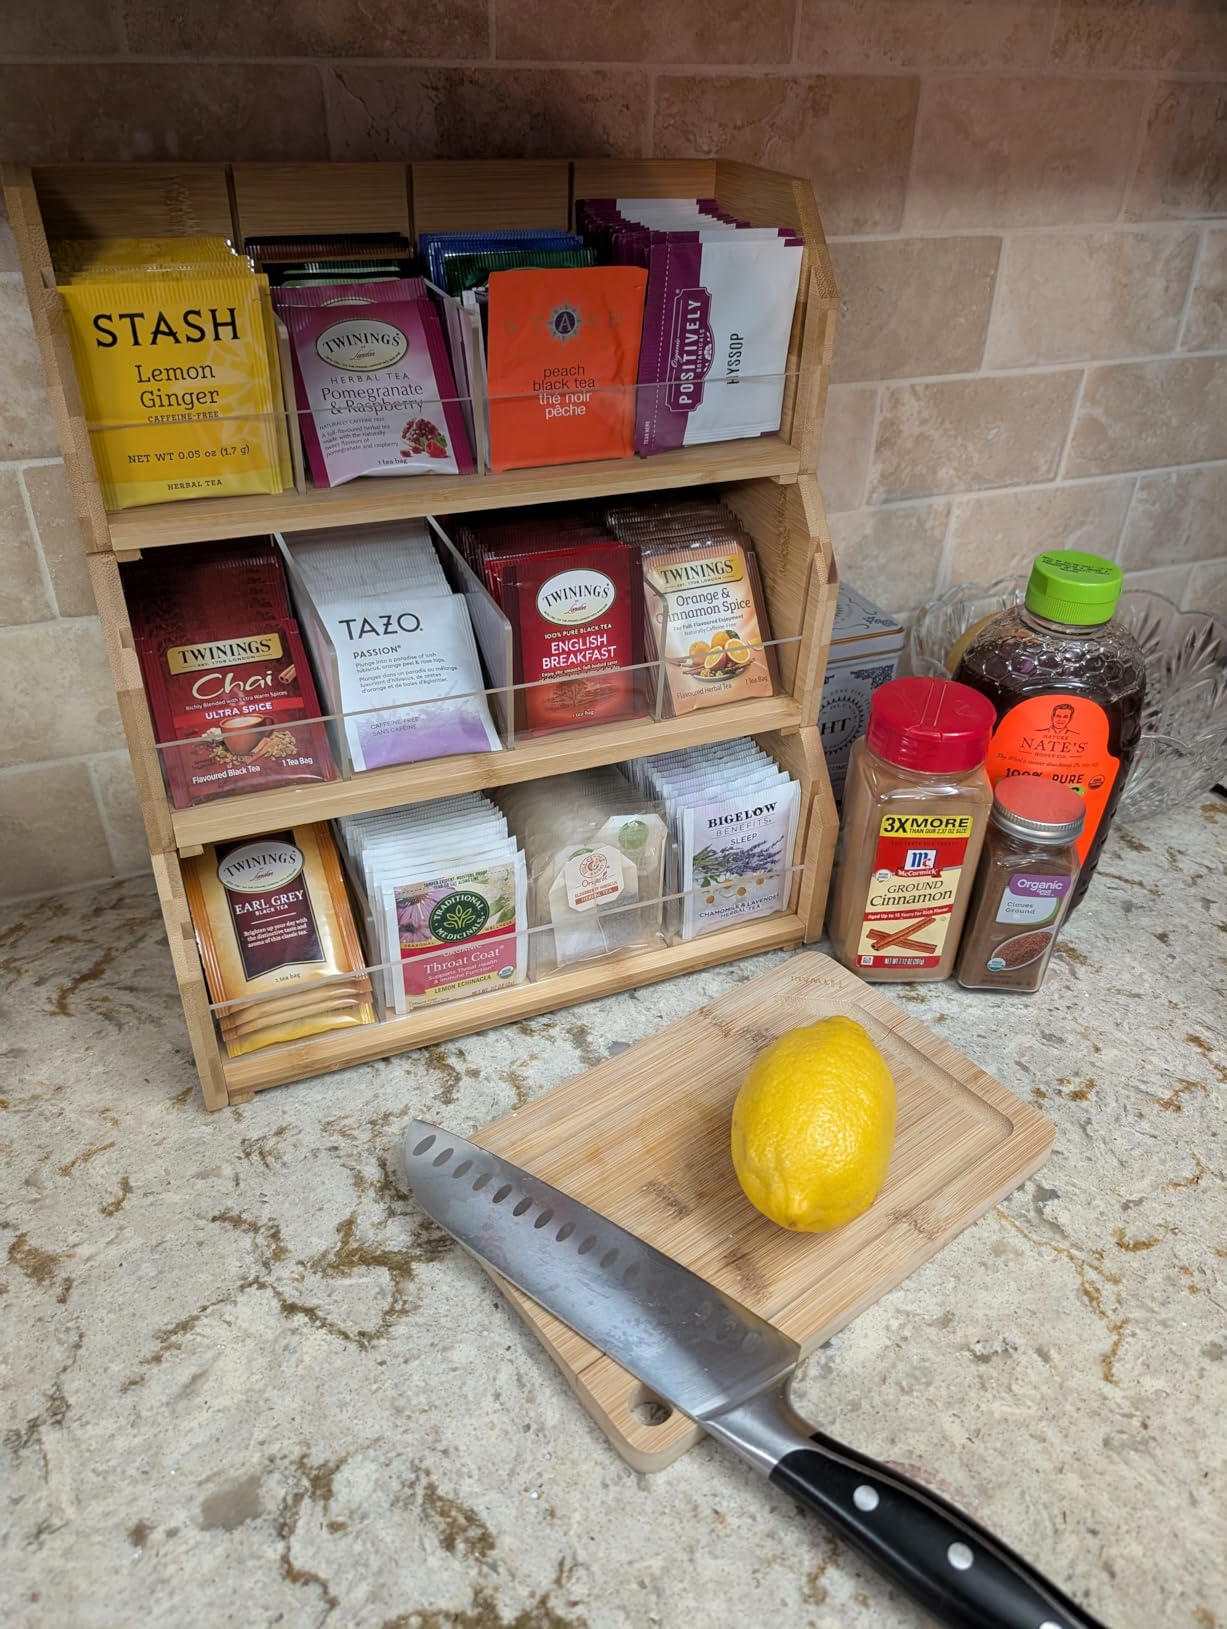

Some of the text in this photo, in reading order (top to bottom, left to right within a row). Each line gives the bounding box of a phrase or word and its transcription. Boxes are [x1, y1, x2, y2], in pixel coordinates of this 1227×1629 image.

[92, 307, 241, 349] STASH
[322, 331, 401, 353] TWININGS
[678, 299, 702, 404] POSITIVELY
[696, 328, 706, 373] BOTANICALS
[726, 332, 744, 386] HYSSOP
[134, 364, 216, 384] Lemon
[330, 372, 410, 385] HERBAL TEA
[543, 364, 585, 380] peach
[321, 383, 424, 402] Pomegranate
[532, 377, 595, 393] black tea
[140, 389, 219, 411] Ginger
[539, 390, 592, 405] thé noir
[147, 410, 219, 424] CAFFEINE-FREE
[330, 398, 424, 417] & Raspberry
[545, 404, 586, 420] pêche
[127, 444, 250, 465] NET WT 0.05 oz (1.7 g)
[167, 479, 222, 491] HERBAL TEA
[660, 558, 734, 584] TWININGS
[542, 582, 610, 608] TWININGS
[676, 587, 731, 608] Orange &
[656, 598, 751, 625] Cinnamon Spice
[544, 623, 613, 640] 100% PURE BLACK TEA
[178, 639, 270, 665] TWININGS
[551, 633, 607, 654] ENGLISH
[542, 645, 617, 670] BREAKFAST
[191, 669, 273, 701] Chai
[758, 675, 769, 684] Bag
[185, 689, 288, 711] Richly Blended with Extra Warm Spices
[676, 682, 733, 700] Flavoured Herbal Tea
[205, 701, 273, 721] ULTRA SPICE
[1020, 736, 1086, 754] NATE'S
[286, 757, 299, 767] Tea
[299, 755, 313, 767] Bag
[192, 764, 261, 786] Flavoured Black Tea
[1051, 773, 1085, 785] PURE
[707, 801, 778, 829] BIGELOW
[716, 818, 769, 837] BENEFITS
[883, 816, 970, 834] 3X MORE
[730, 832, 758, 846] SLEEP
[224, 850, 296, 877] TWININGS
[898, 867, 937, 877] McCormick
[887, 880, 944, 894] GROUND
[1017, 878, 1064, 892] Organic
[234, 889, 304, 916] EARL GREY
[433, 894, 484, 920] TRADITIONAL
[869, 889, 953, 907] Cinnamon
[255, 904, 289, 916] BLACK TEA
[699, 904, 740, 919] CHAMOMILE
[720, 904, 761, 920] HERBAL TEA
[1004, 907, 1036, 915] Ground
[243, 916, 308, 938] Brighten up your day with
[247, 933, 257, 942] the
[257, 928, 284, 940] distinctive
[297, 923, 308, 931] and
[435, 915, 485, 940] MEDICINALS
[423, 957, 469, 975] Throat
[471, 947, 500, 963] Coat
[434, 982, 456, 994] LEMON
[457, 974, 492, 988] ECHINACEA
